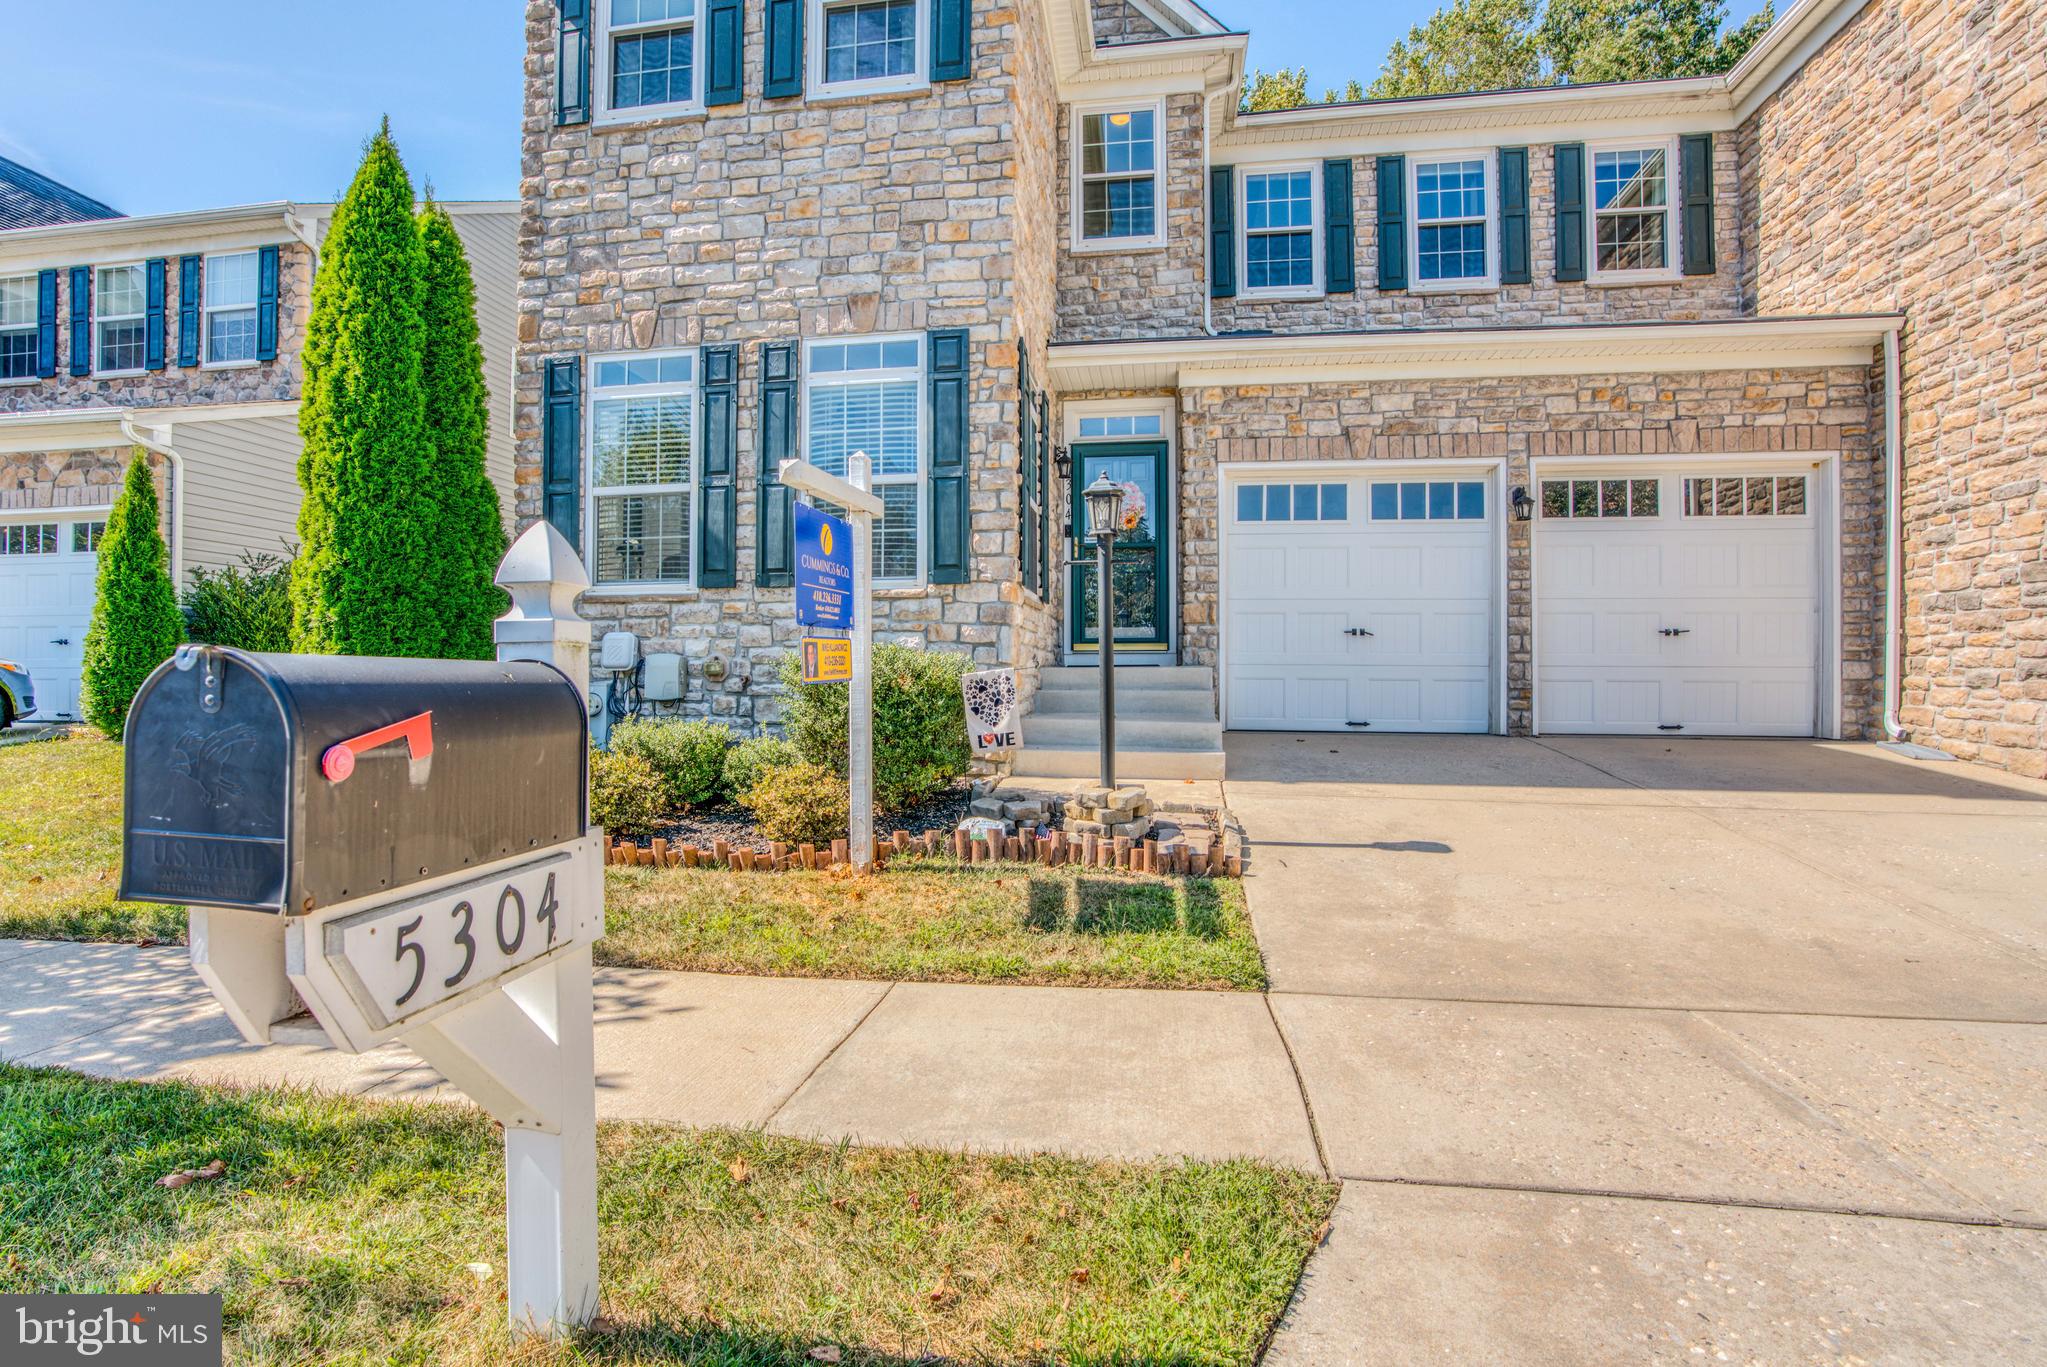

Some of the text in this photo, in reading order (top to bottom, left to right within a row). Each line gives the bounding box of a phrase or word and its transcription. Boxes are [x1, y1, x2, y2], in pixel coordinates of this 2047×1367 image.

[801, 554, 836, 575] CUMMINGS
[153, 840, 192, 868] U.S.
[396, 872, 559, 1006] 5304
